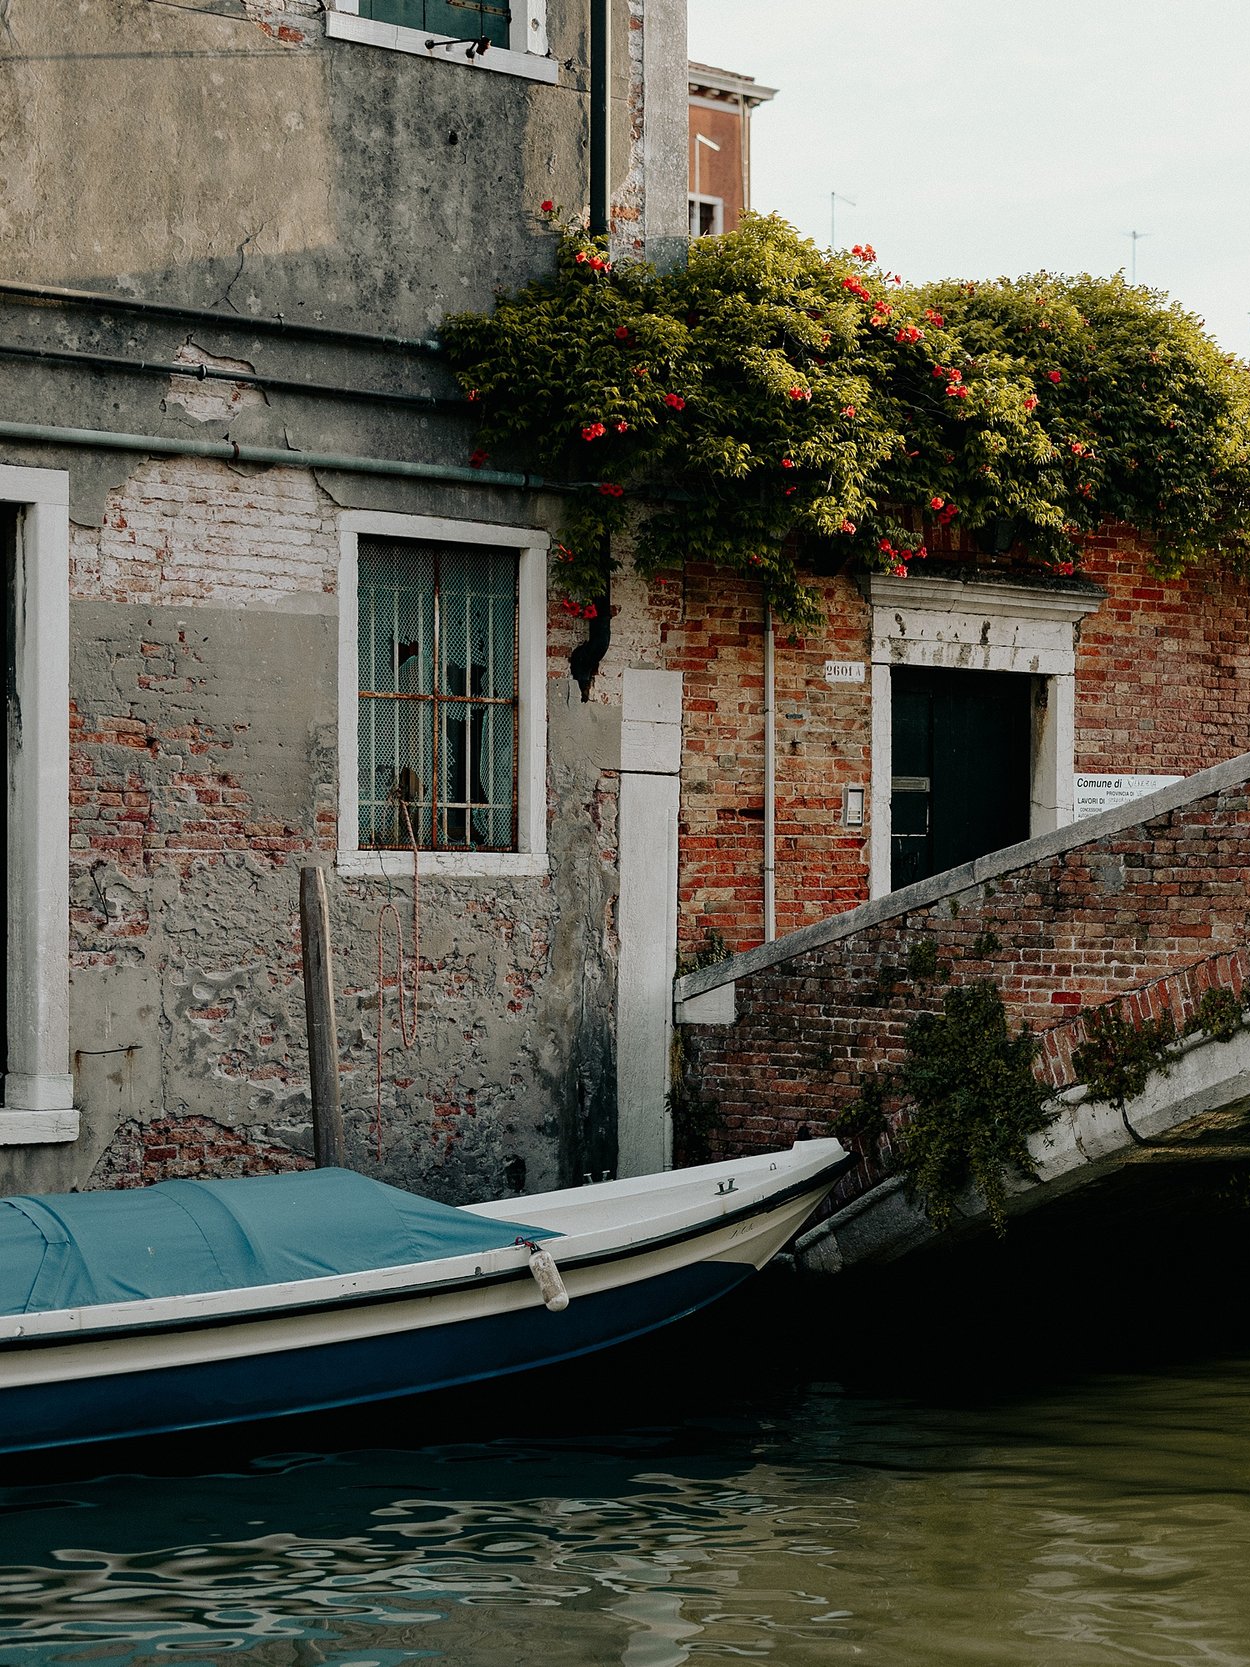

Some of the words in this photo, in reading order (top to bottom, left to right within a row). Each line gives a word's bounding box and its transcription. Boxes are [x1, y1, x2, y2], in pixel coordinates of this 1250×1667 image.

[826, 665, 852, 676] 2601
[1077, 778, 1112, 788] Comune
[1114, 778, 1122, 788] di
